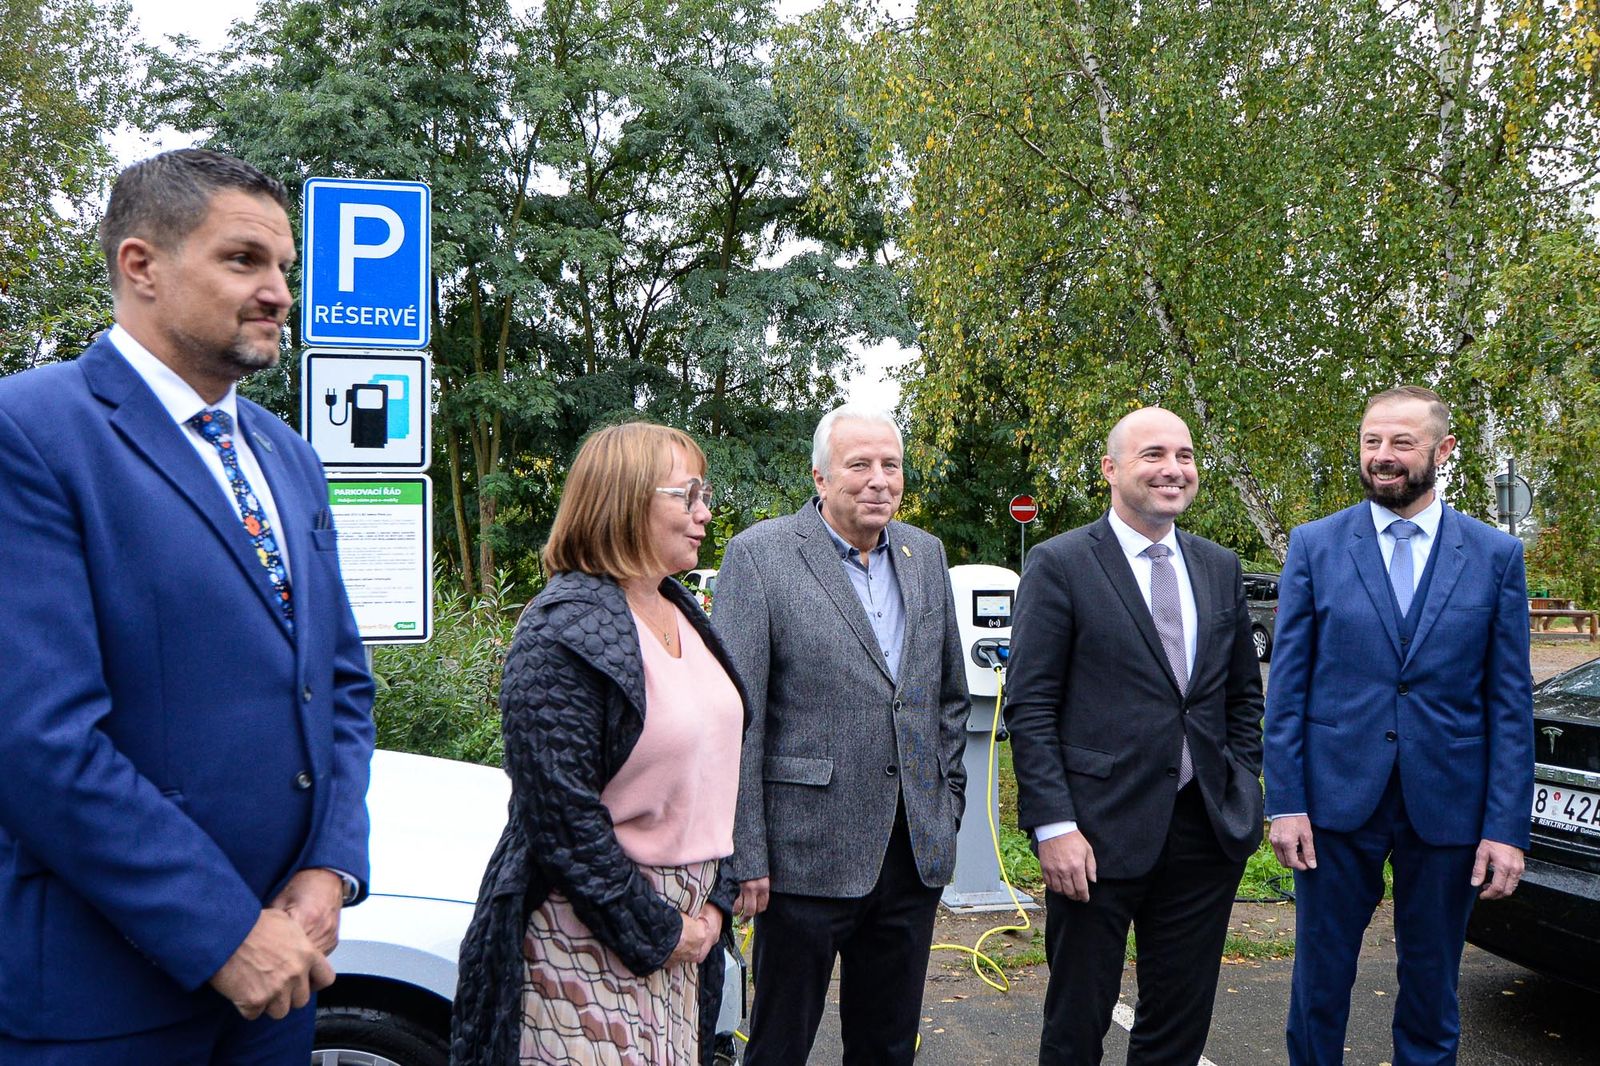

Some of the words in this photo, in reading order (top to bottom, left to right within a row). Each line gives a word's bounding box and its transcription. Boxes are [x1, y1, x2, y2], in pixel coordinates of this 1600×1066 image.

[338, 203, 405, 292] P
[315, 302, 417, 327] RÉSERVÉ
[334, 487, 382, 496] PARKOVACÍ
[383, 486, 402, 496] ŘÁD
[1535, 788, 1548, 814] 8
[1538, 818, 1579, 833] RENT.TRY.BUY
